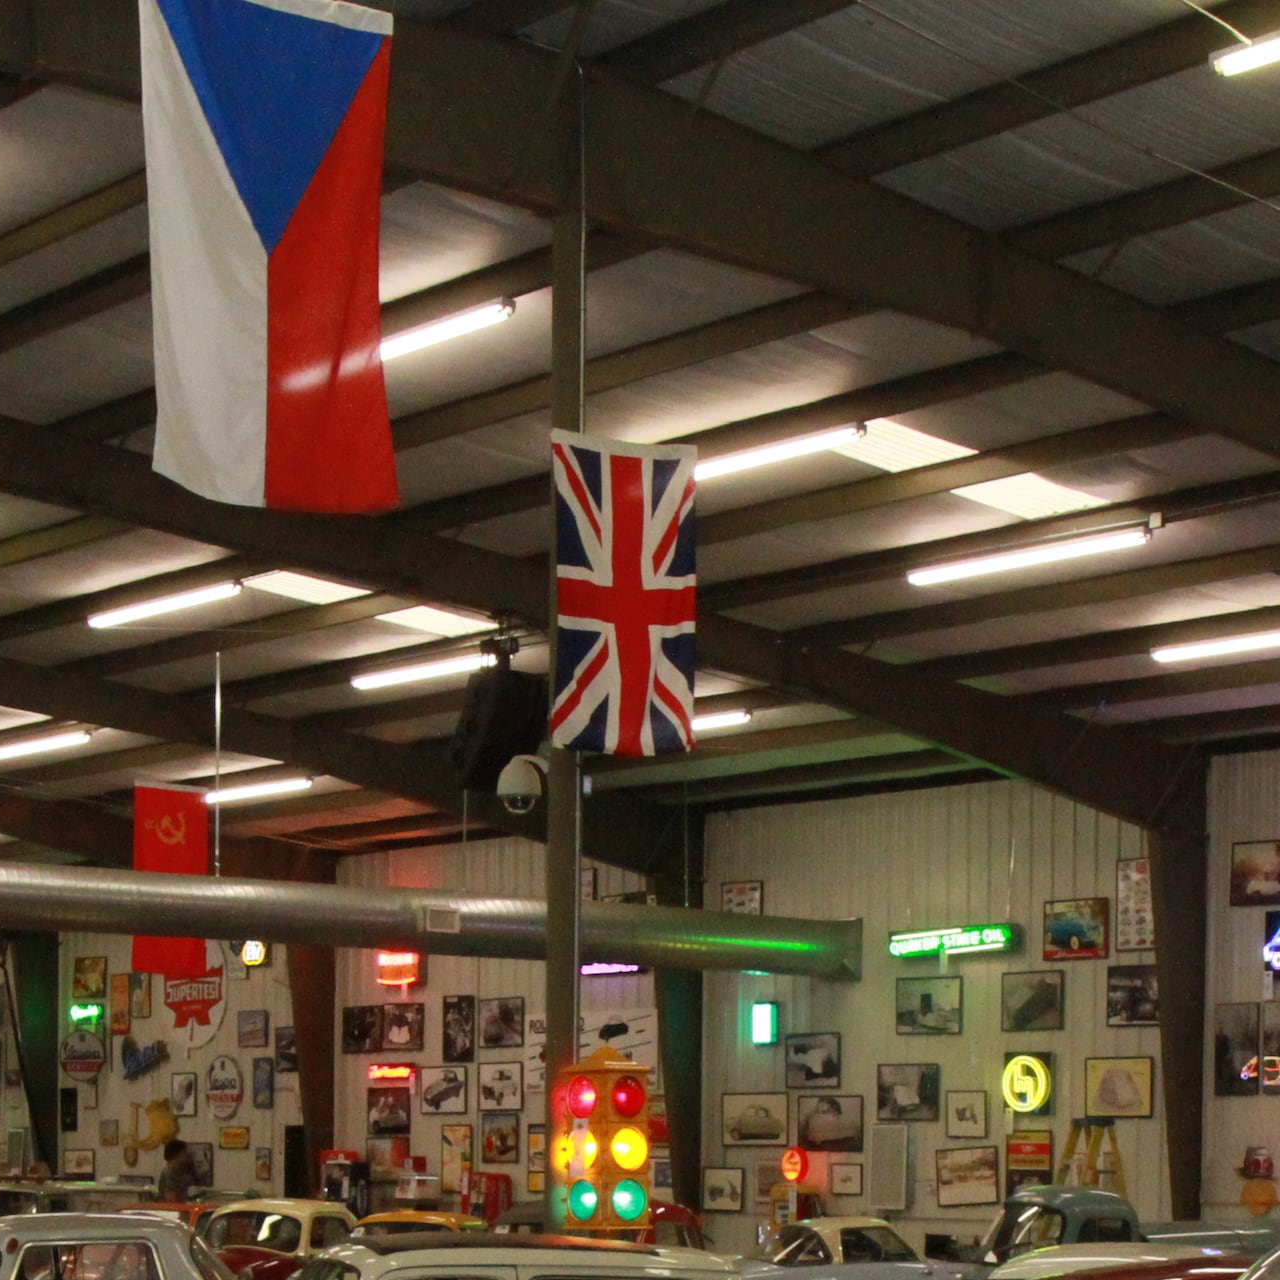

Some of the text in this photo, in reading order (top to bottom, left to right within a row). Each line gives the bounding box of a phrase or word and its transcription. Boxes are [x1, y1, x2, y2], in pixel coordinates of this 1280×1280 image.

[889, 928, 1006, 956] QUAKER STATE OIL
